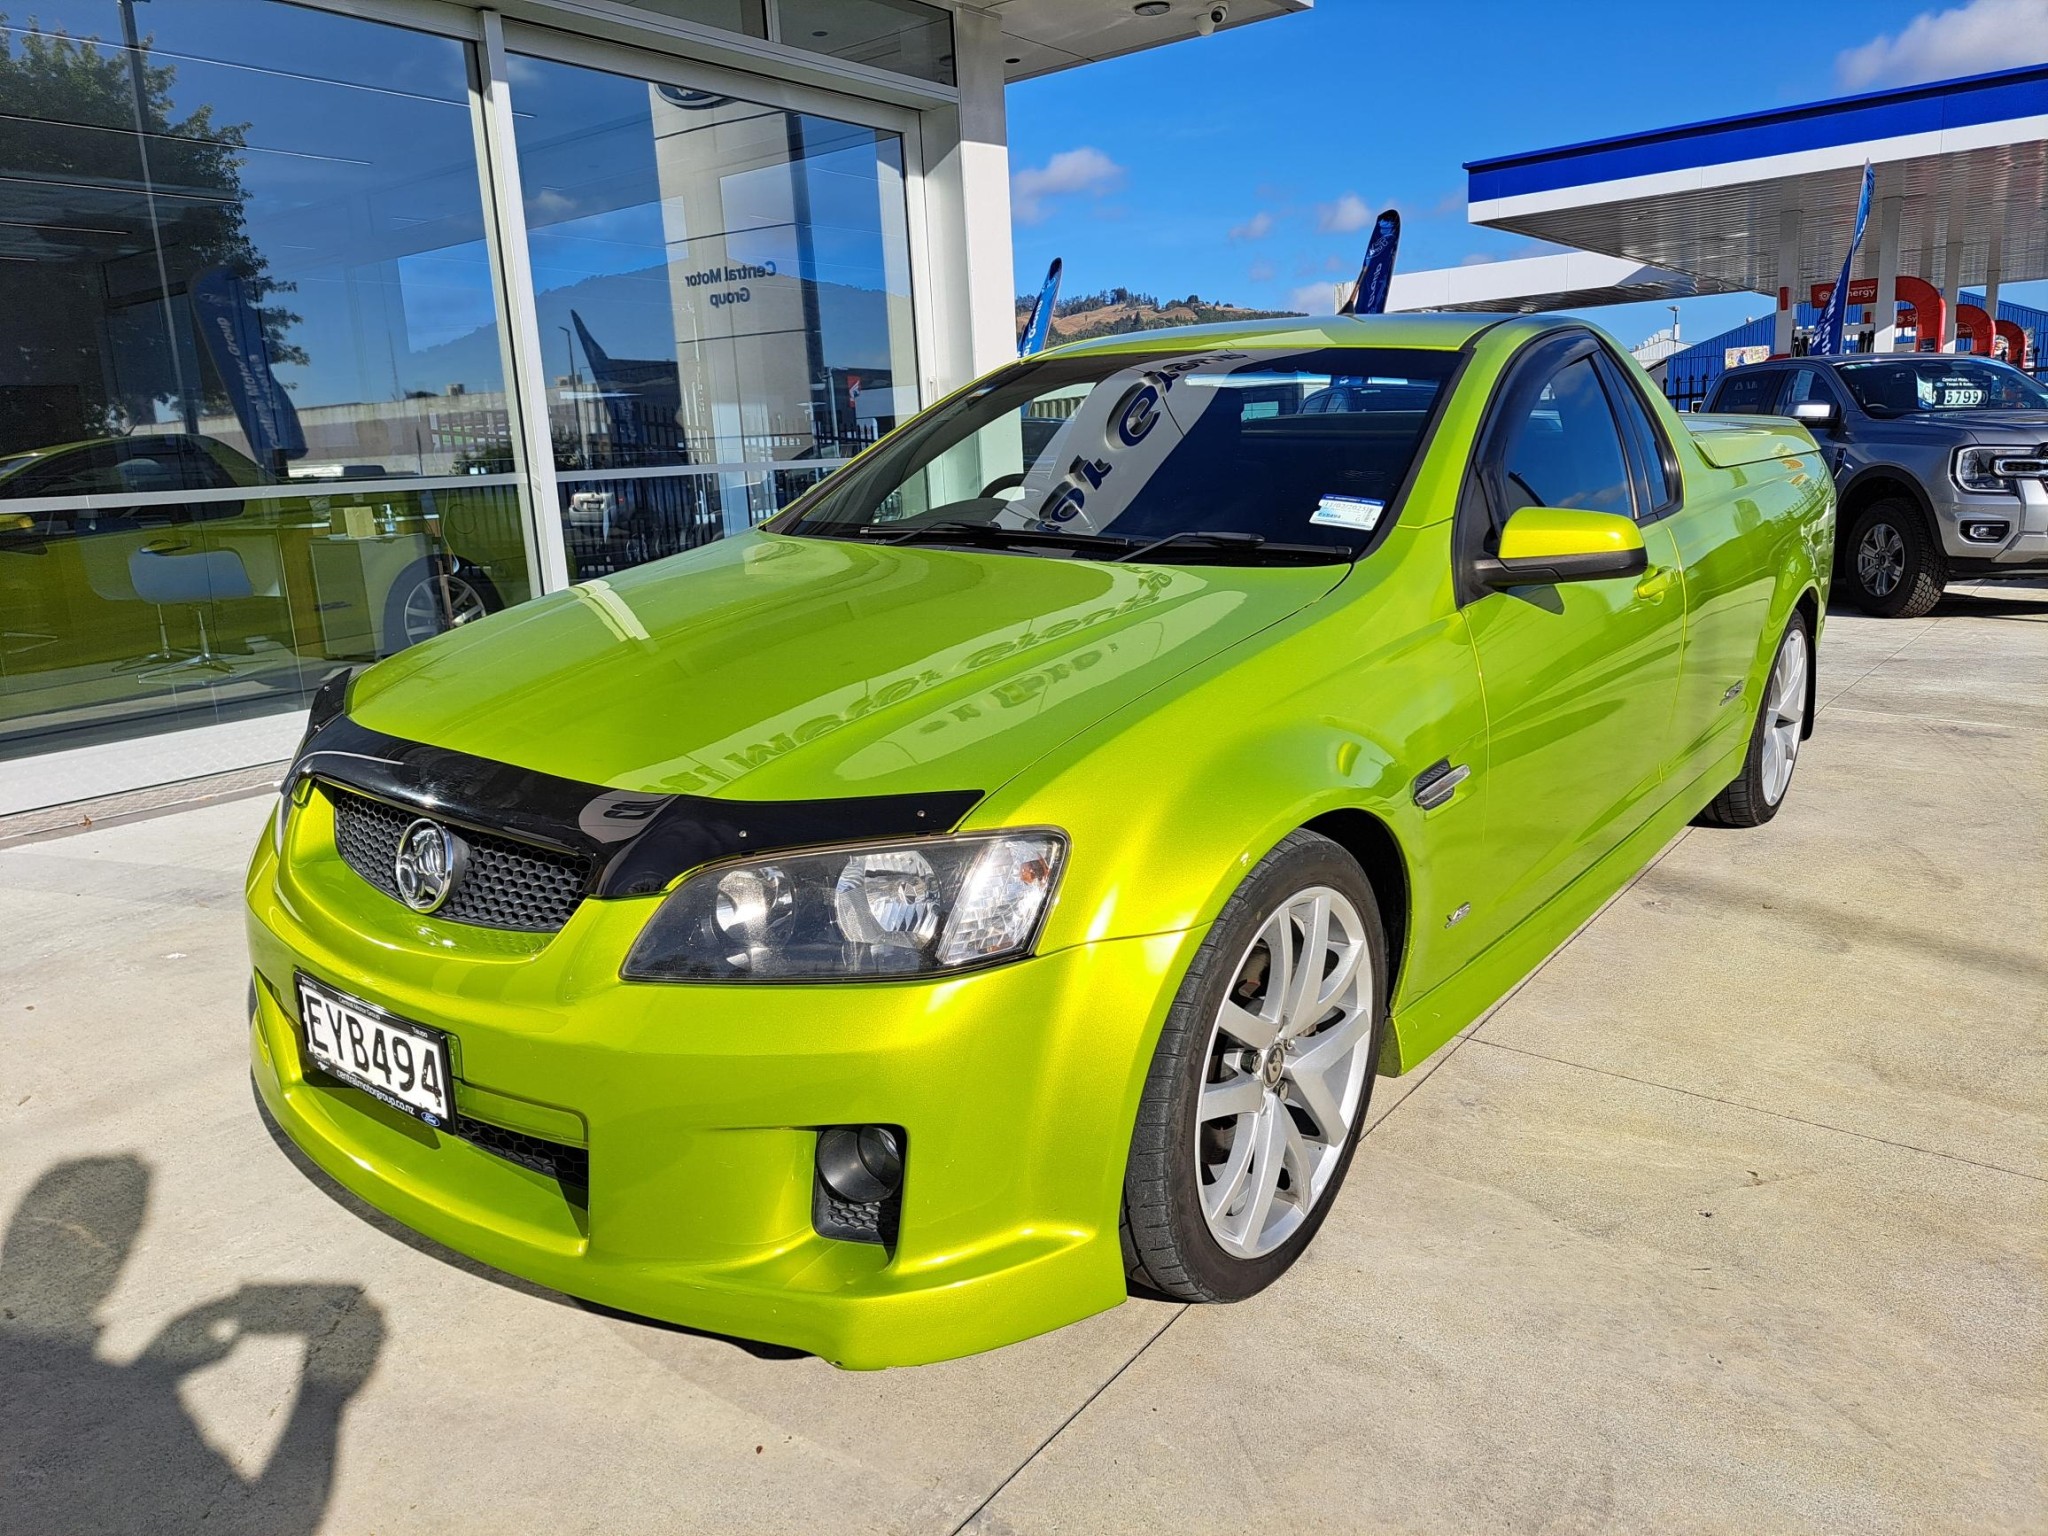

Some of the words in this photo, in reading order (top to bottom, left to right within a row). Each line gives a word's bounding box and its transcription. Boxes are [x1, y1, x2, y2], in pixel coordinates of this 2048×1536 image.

[216, 317, 241, 357] Group
[305, 994, 442, 1108] EYB494
[336, 1069, 415, 1116] centralmotorgroup.co.nz
